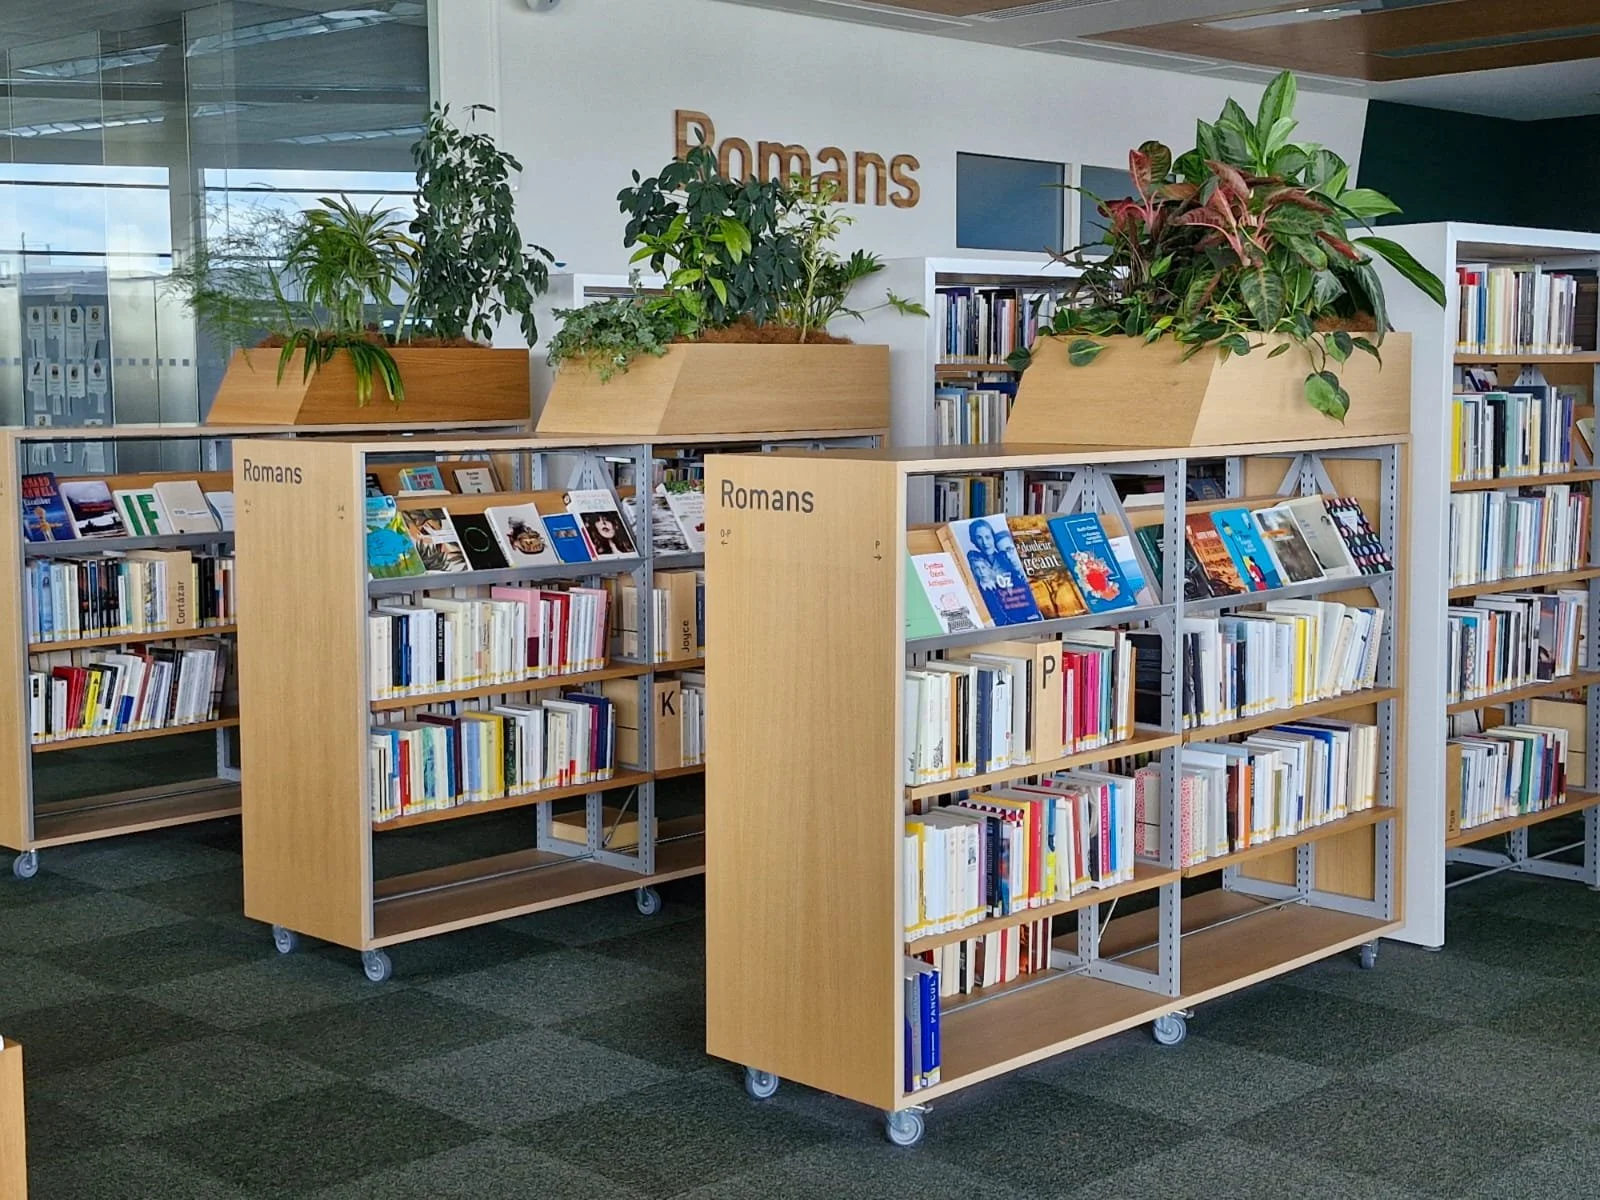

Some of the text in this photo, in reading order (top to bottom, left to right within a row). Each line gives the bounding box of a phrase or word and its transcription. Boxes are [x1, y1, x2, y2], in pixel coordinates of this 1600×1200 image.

[674, 110, 920, 208] Romans
[243, 458, 302, 484] Romans
[721, 480, 814, 513] Romans
[875, 540, 881, 549] P
[1021, 541, 1053, 553] douleur
[1023, 554, 1061, 576] géant
[997, 573, 1013, 588] Oz
[176, 580, 185, 625] Cortázar
[681, 620, 692, 653] Joyce
[1042, 655, 1056, 689] P
[661, 691, 675, 717] K
